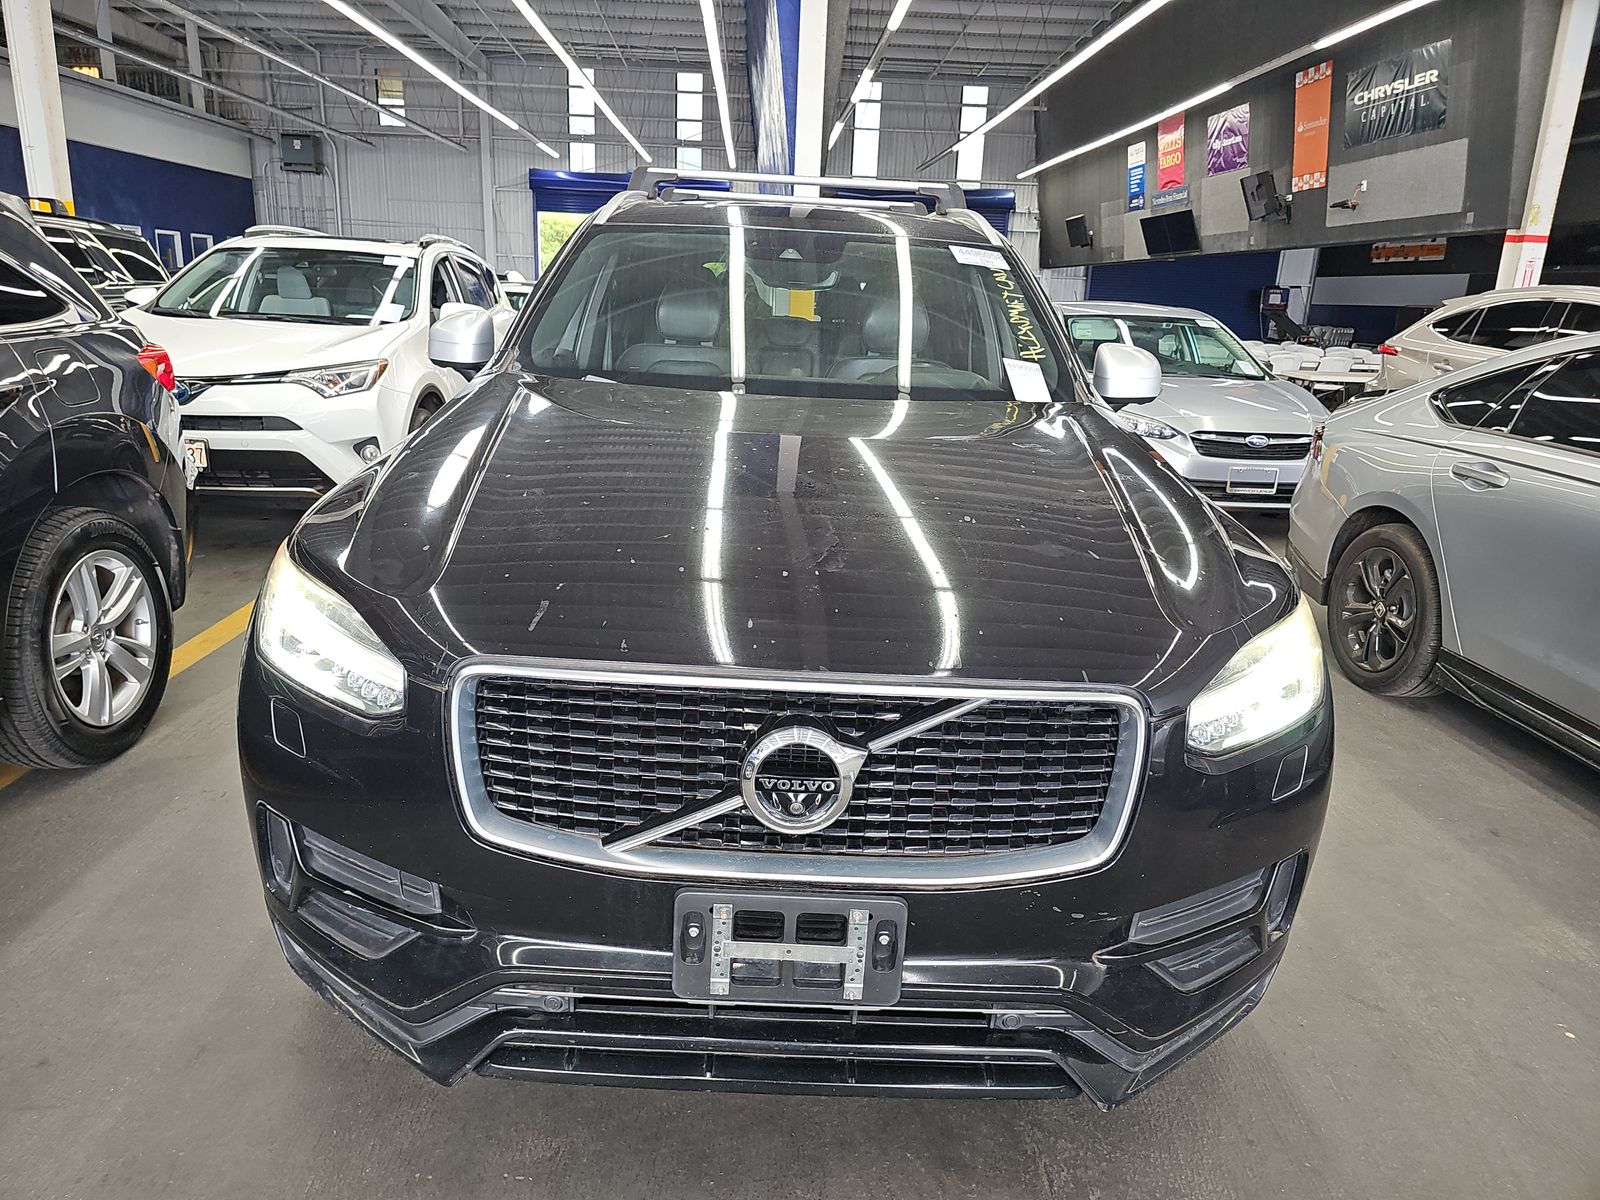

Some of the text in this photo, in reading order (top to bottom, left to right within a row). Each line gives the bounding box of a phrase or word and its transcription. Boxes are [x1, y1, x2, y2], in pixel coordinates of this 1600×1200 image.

[1354, 69, 1439, 105] CHRYSLER
[1160, 137, 1181, 152] WELLS
[1160, 153, 1181, 169] FARGO
[758, 778, 836, 792] VOLVO
